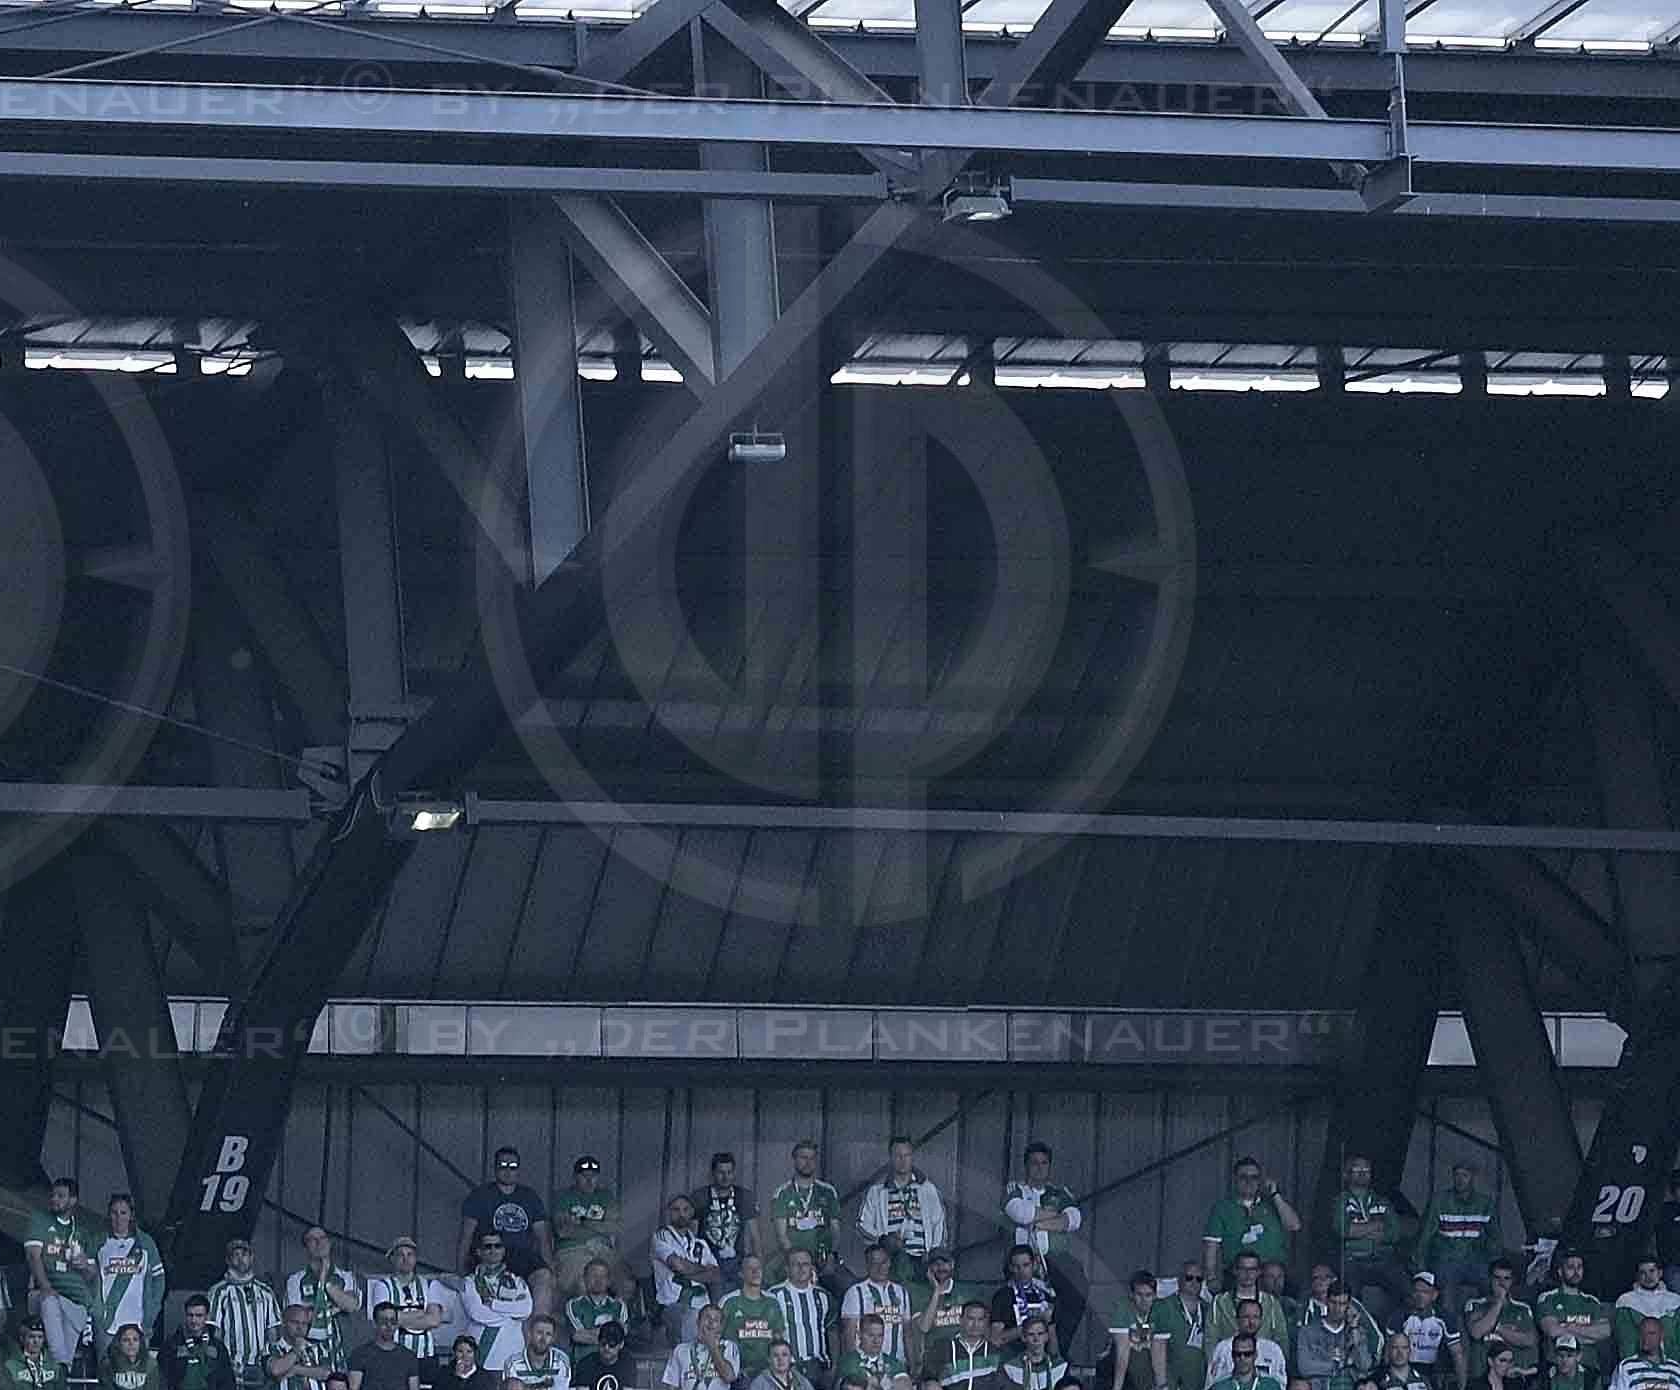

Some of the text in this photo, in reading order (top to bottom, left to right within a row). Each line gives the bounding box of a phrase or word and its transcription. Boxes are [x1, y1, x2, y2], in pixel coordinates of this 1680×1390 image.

[216, 1135, 249, 1173] B
[201, 1174, 251, 1213] 19
[1591, 1185, 1647, 1223] 20
